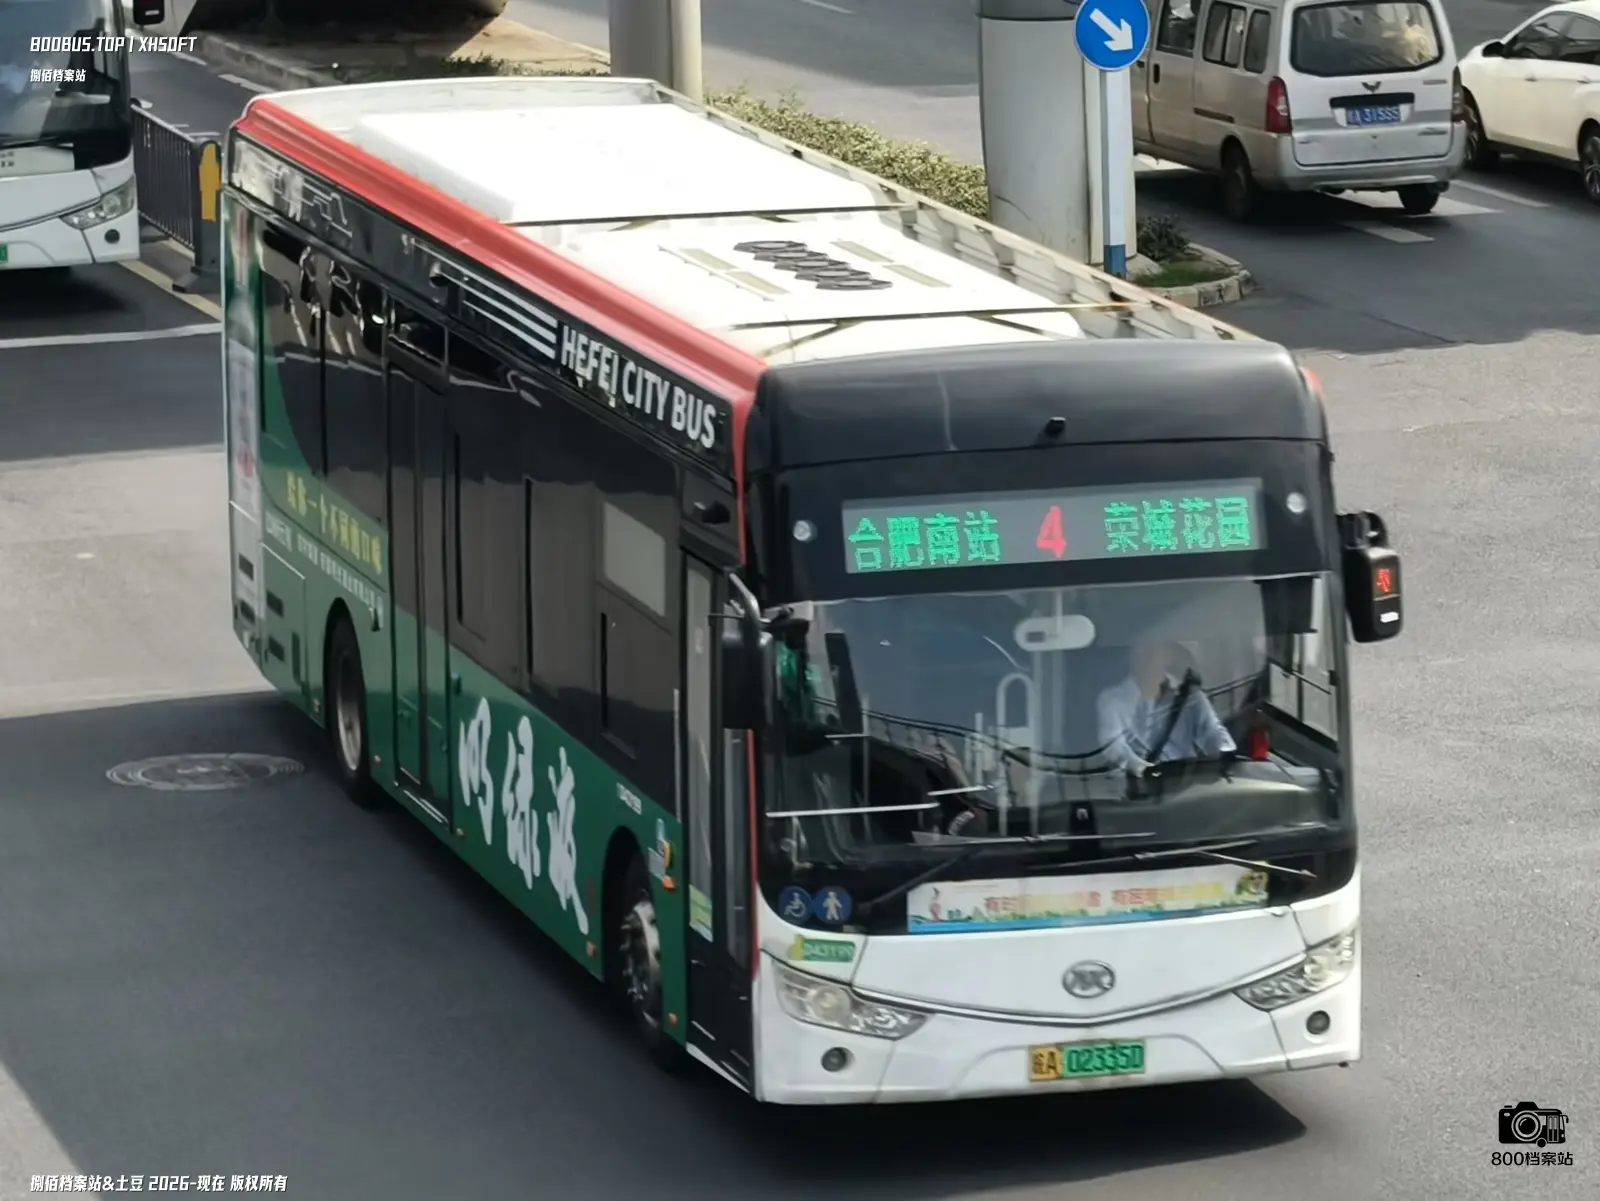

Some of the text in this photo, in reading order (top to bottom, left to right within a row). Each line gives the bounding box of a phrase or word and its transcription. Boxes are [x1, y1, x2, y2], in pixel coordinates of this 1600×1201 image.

[560, 325, 717, 449] HEFEI CITY BUS
[847, 509, 1002, 571] 合肥南站
[1035, 505, 1068, 560] 4
